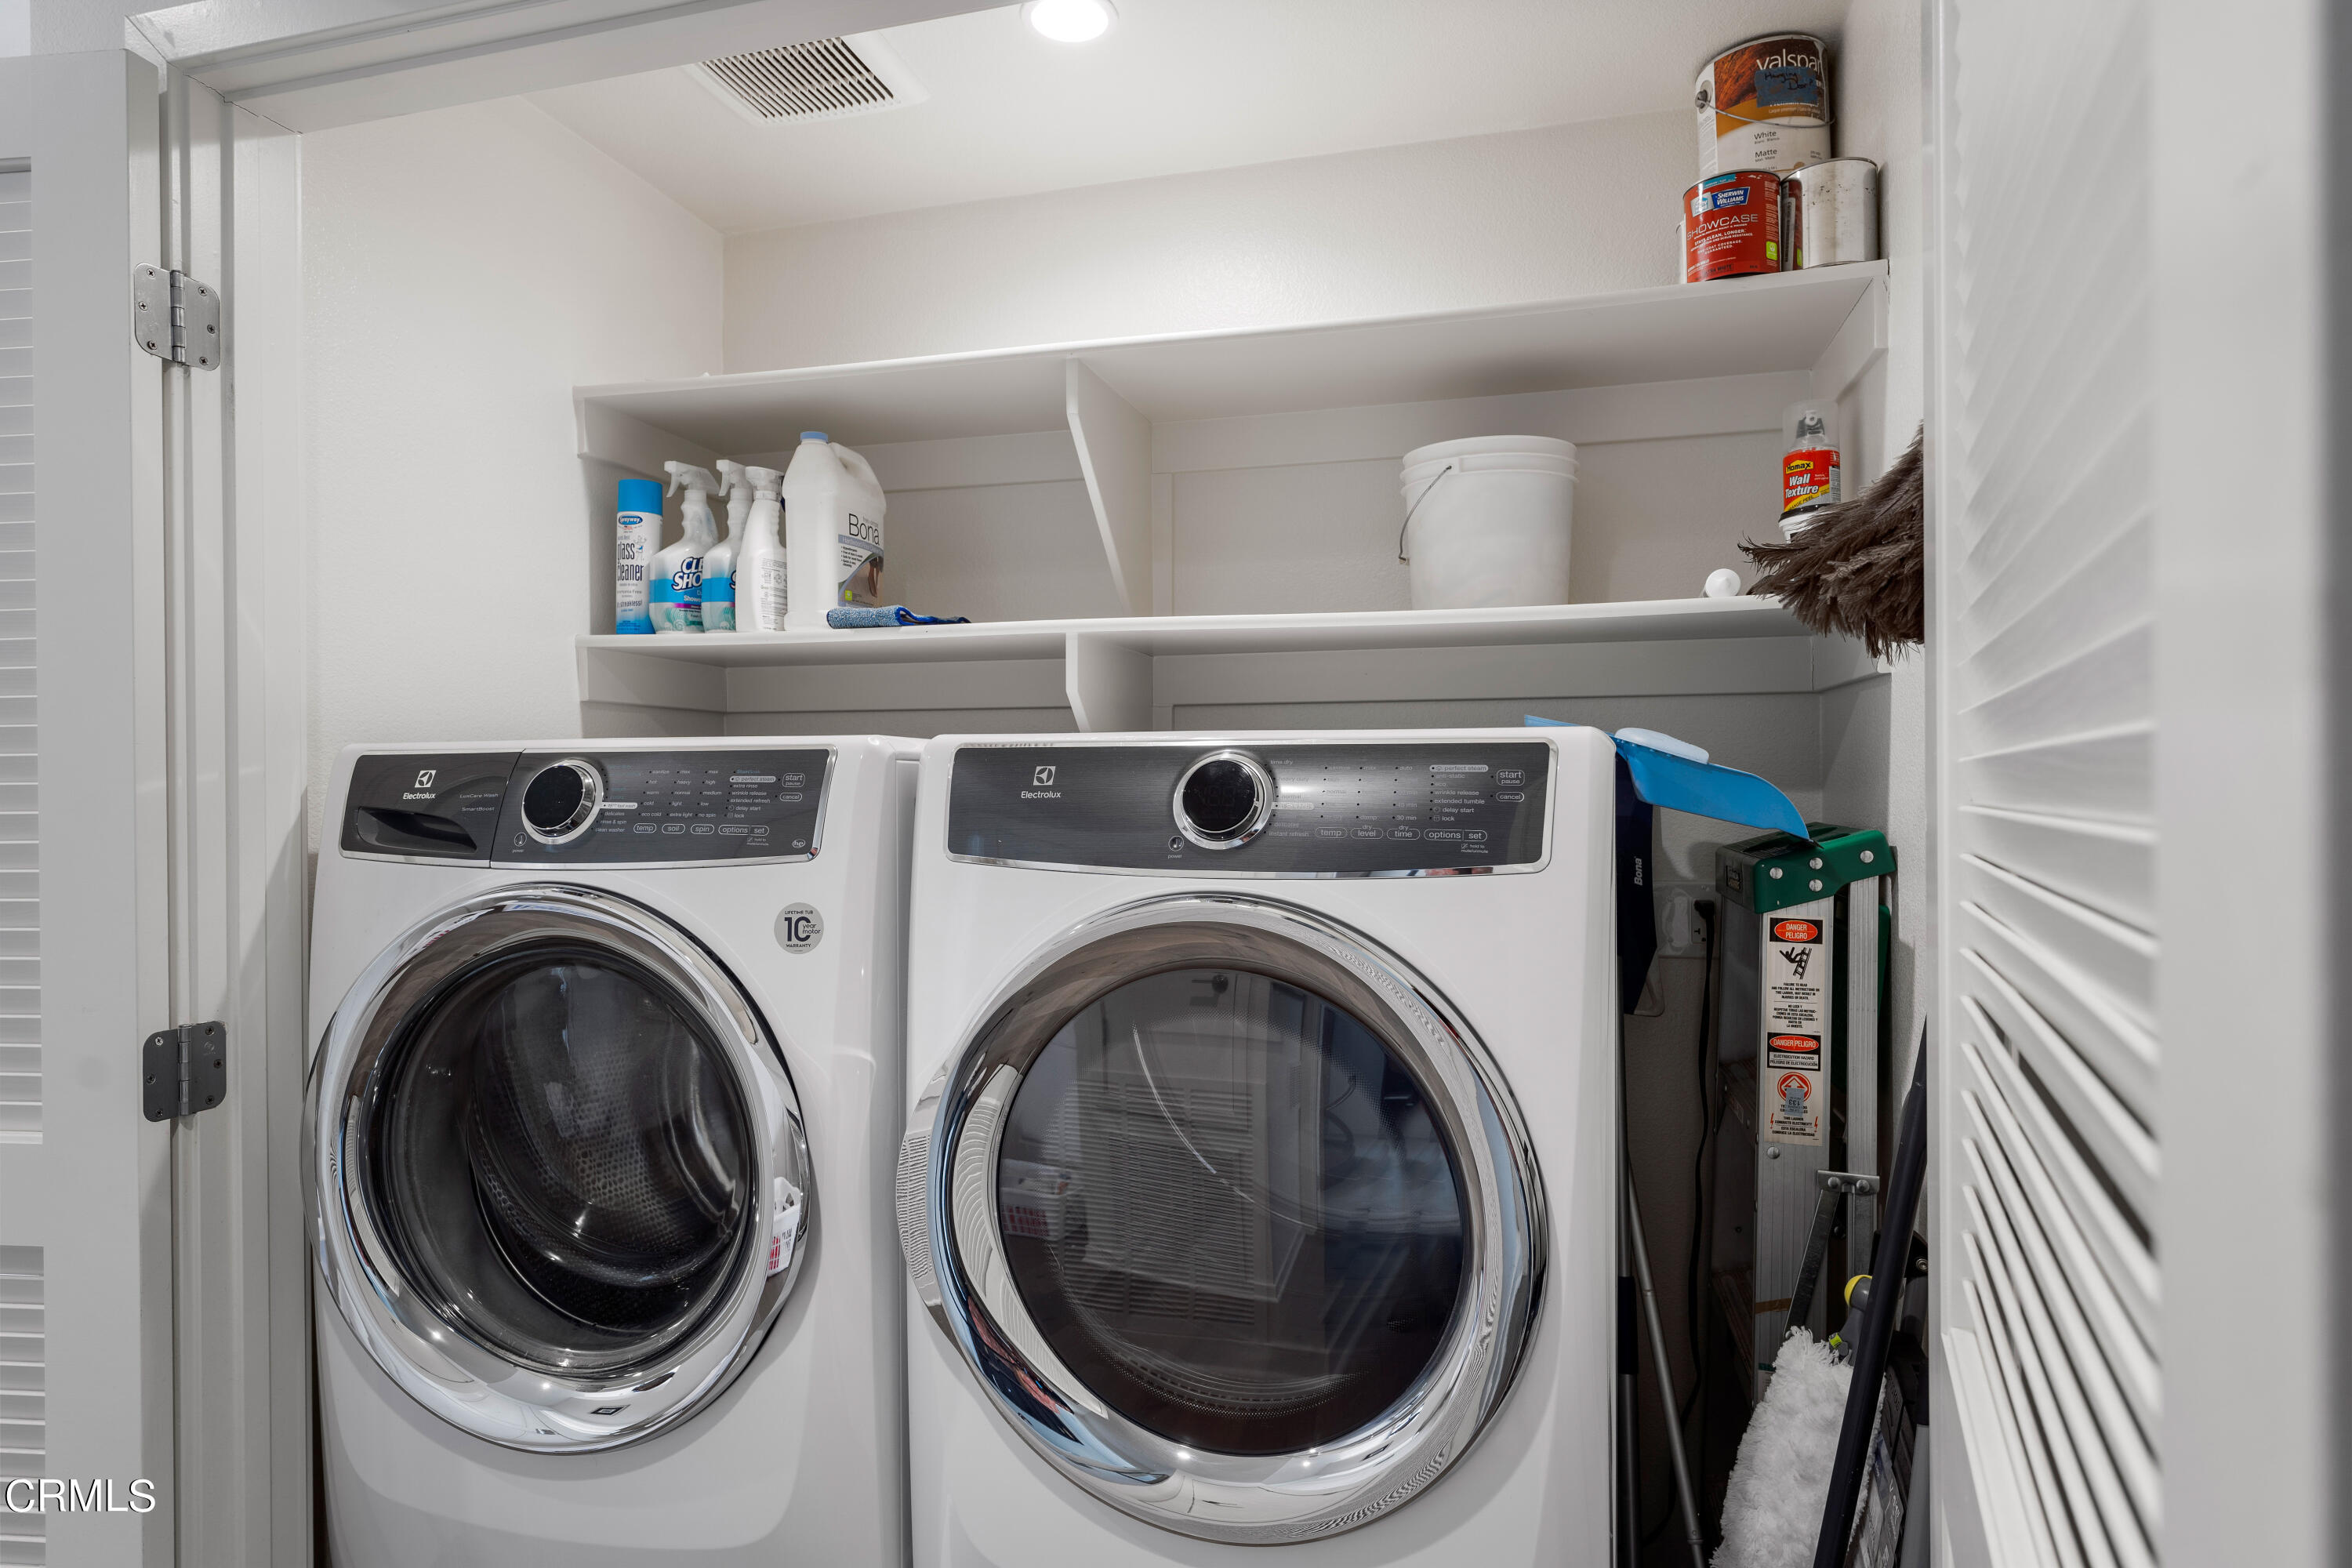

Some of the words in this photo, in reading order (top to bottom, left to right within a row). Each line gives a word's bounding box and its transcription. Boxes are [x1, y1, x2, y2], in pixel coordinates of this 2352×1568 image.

[1754, 131, 1777, 140] White
[1755, 149, 1777, 158] Matte
[1717, 196, 1744, 205] WILLIAMS
[1718, 190, 1744, 199] SHERWIN
[1686, 214, 1759, 241] SHOWCASE
[1788, 462, 1811, 472] Homax
[1789, 474, 1811, 487] Wall
[1785, 485, 1818, 499] Texture
[848, 513, 880, 546] Bona
[618, 541, 635, 564] glass
[618, 562, 644, 582] cleaner
[681, 557, 703, 574] CLE
[671, 572, 703, 590] SHO
[1021, 790, 1062, 799] Electrolux
